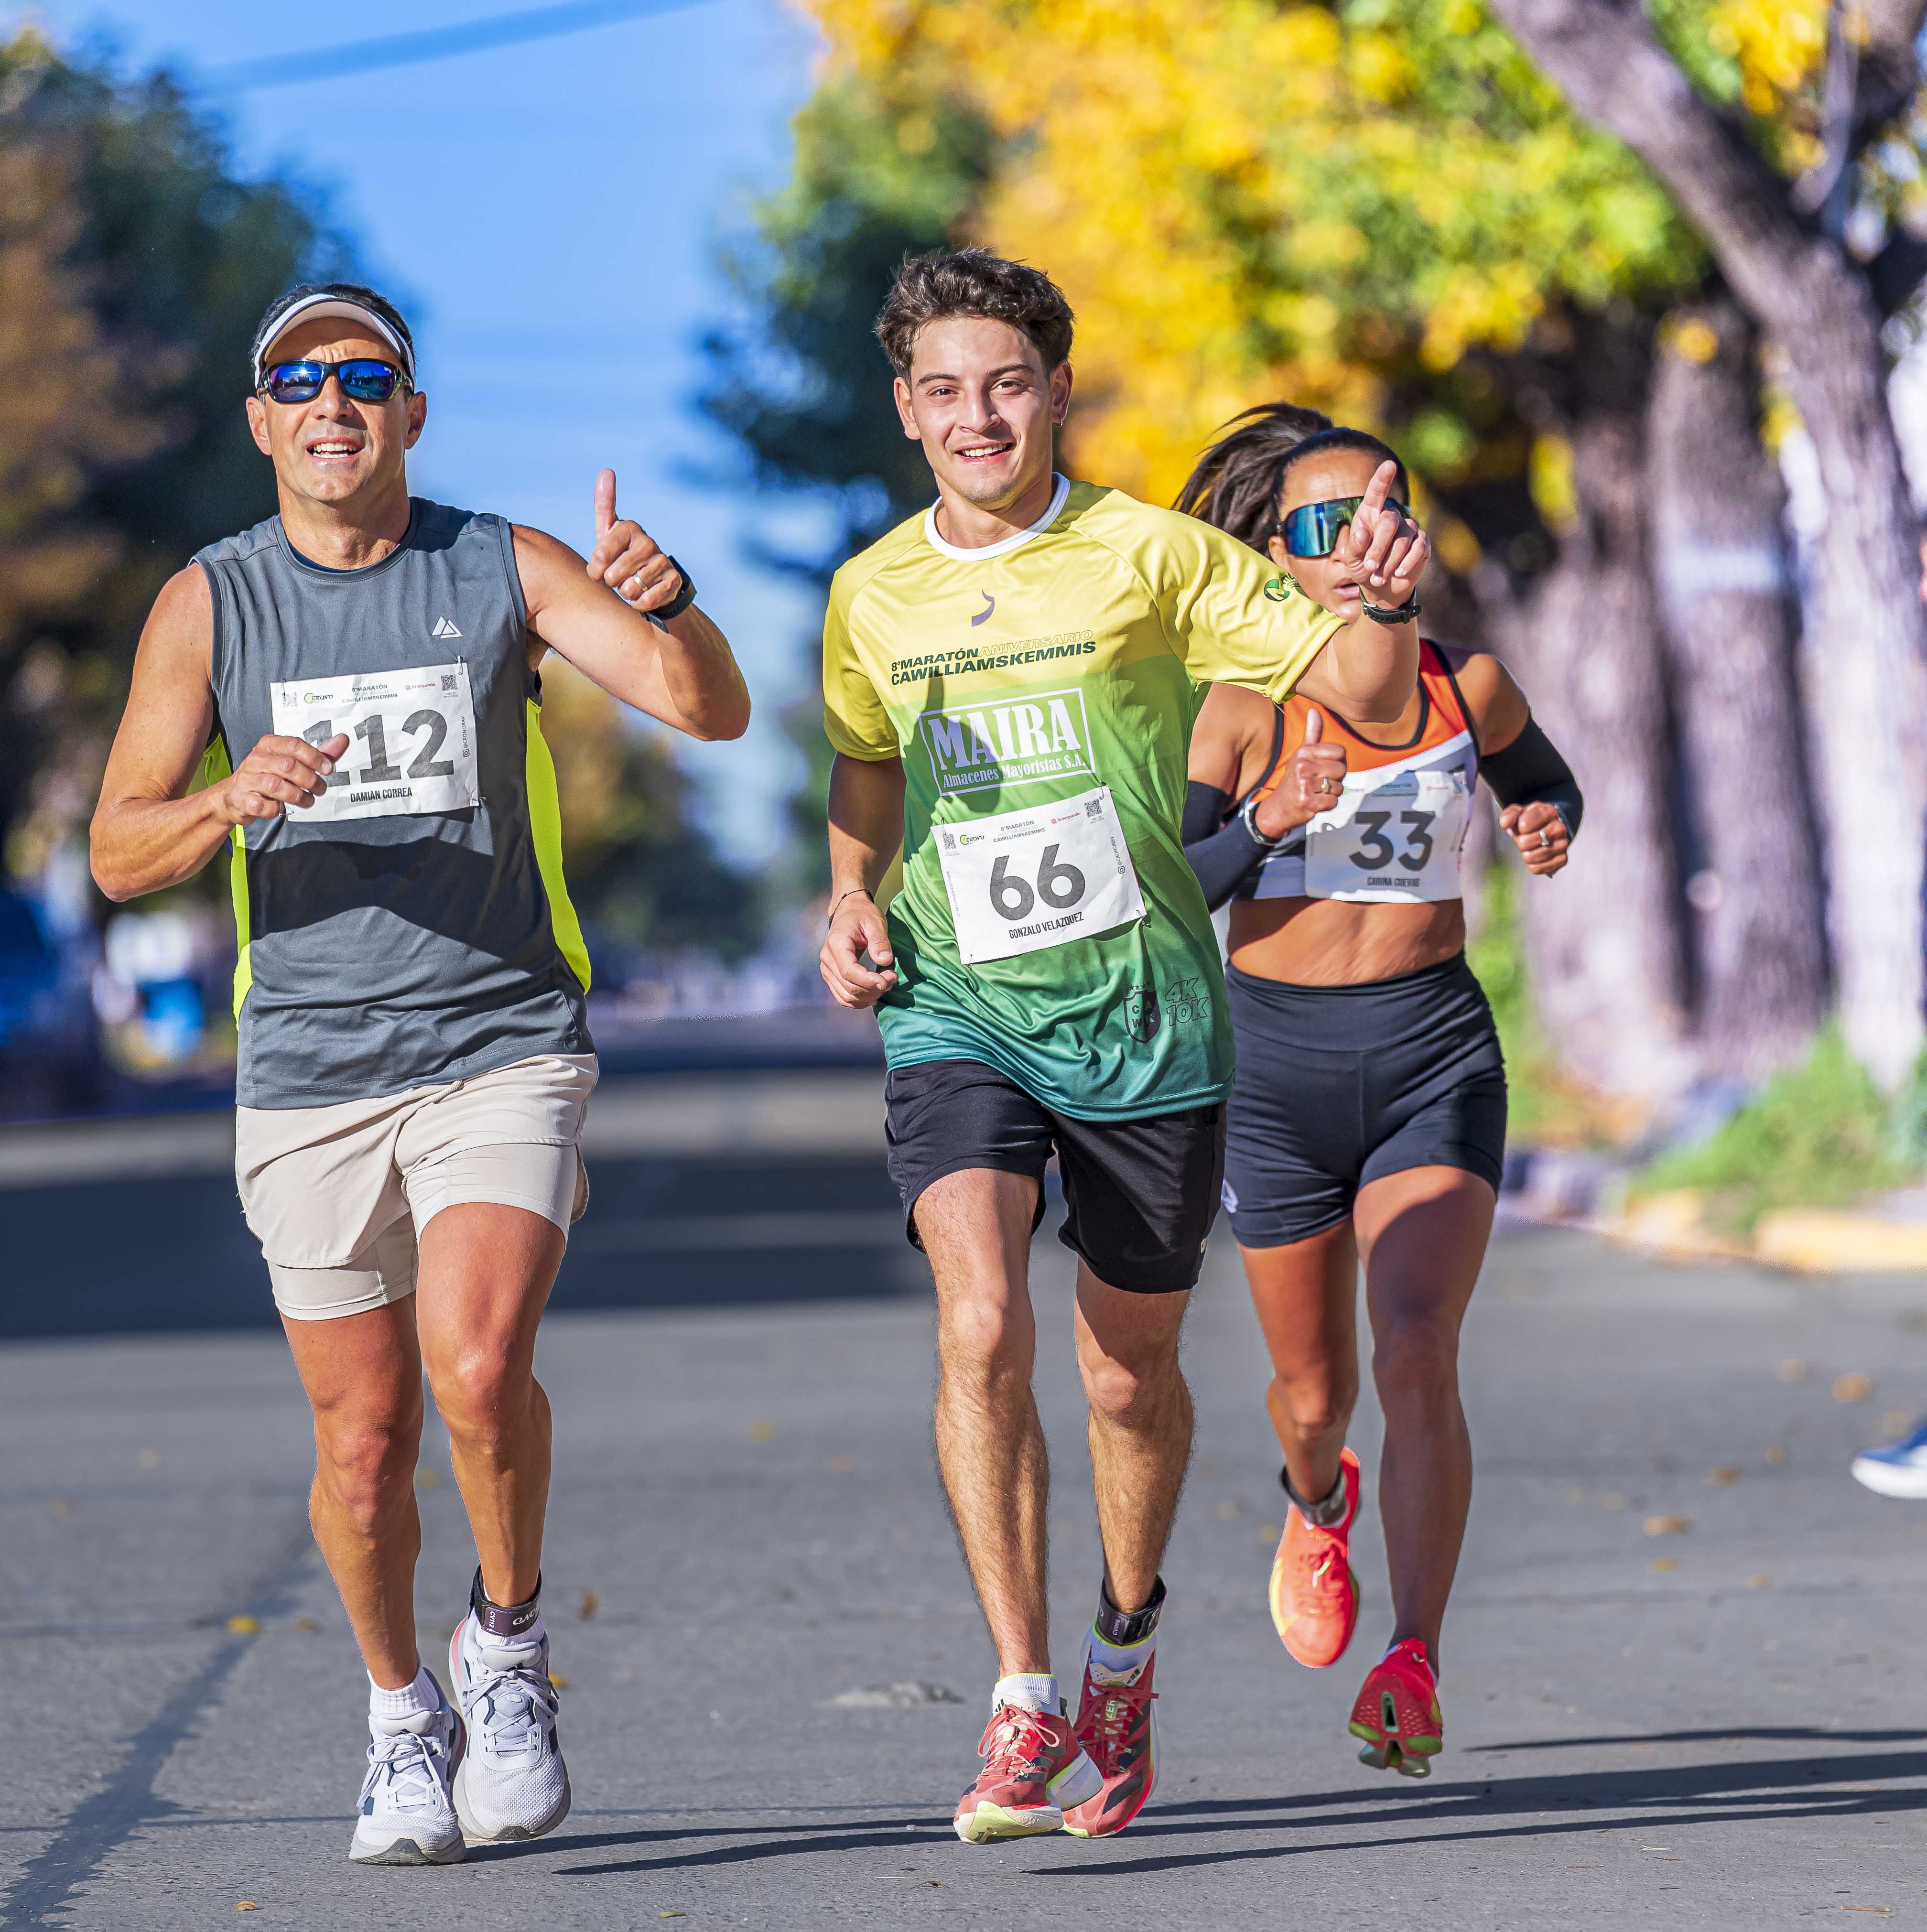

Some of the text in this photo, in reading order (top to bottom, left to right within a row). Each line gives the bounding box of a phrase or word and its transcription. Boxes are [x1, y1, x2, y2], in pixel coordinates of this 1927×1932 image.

[978, 629, 1093, 657] ANIVERSARIO
[891, 641, 1096, 685] CAWILLIAMSKEMMIS
[928, 699, 1081, 771] MAIRA
[943, 754, 1086, 788] Almacenes Mayoristas S.A.
[350, 787, 412, 803] DAMIAN CORREA
[993, 828, 1045, 842] CAWILLIAMSKEMMIS
[1348, 811, 1436, 872] 33
[1109, 836, 1122, 866] @CRONORAV
[990, 843, 1085, 920] 66
[1009, 912, 1084, 939] GONZALO VELAZQUEZ
[1165, 977, 1199, 1003] 4K
[1166, 996, 1209, 1026] 10K
